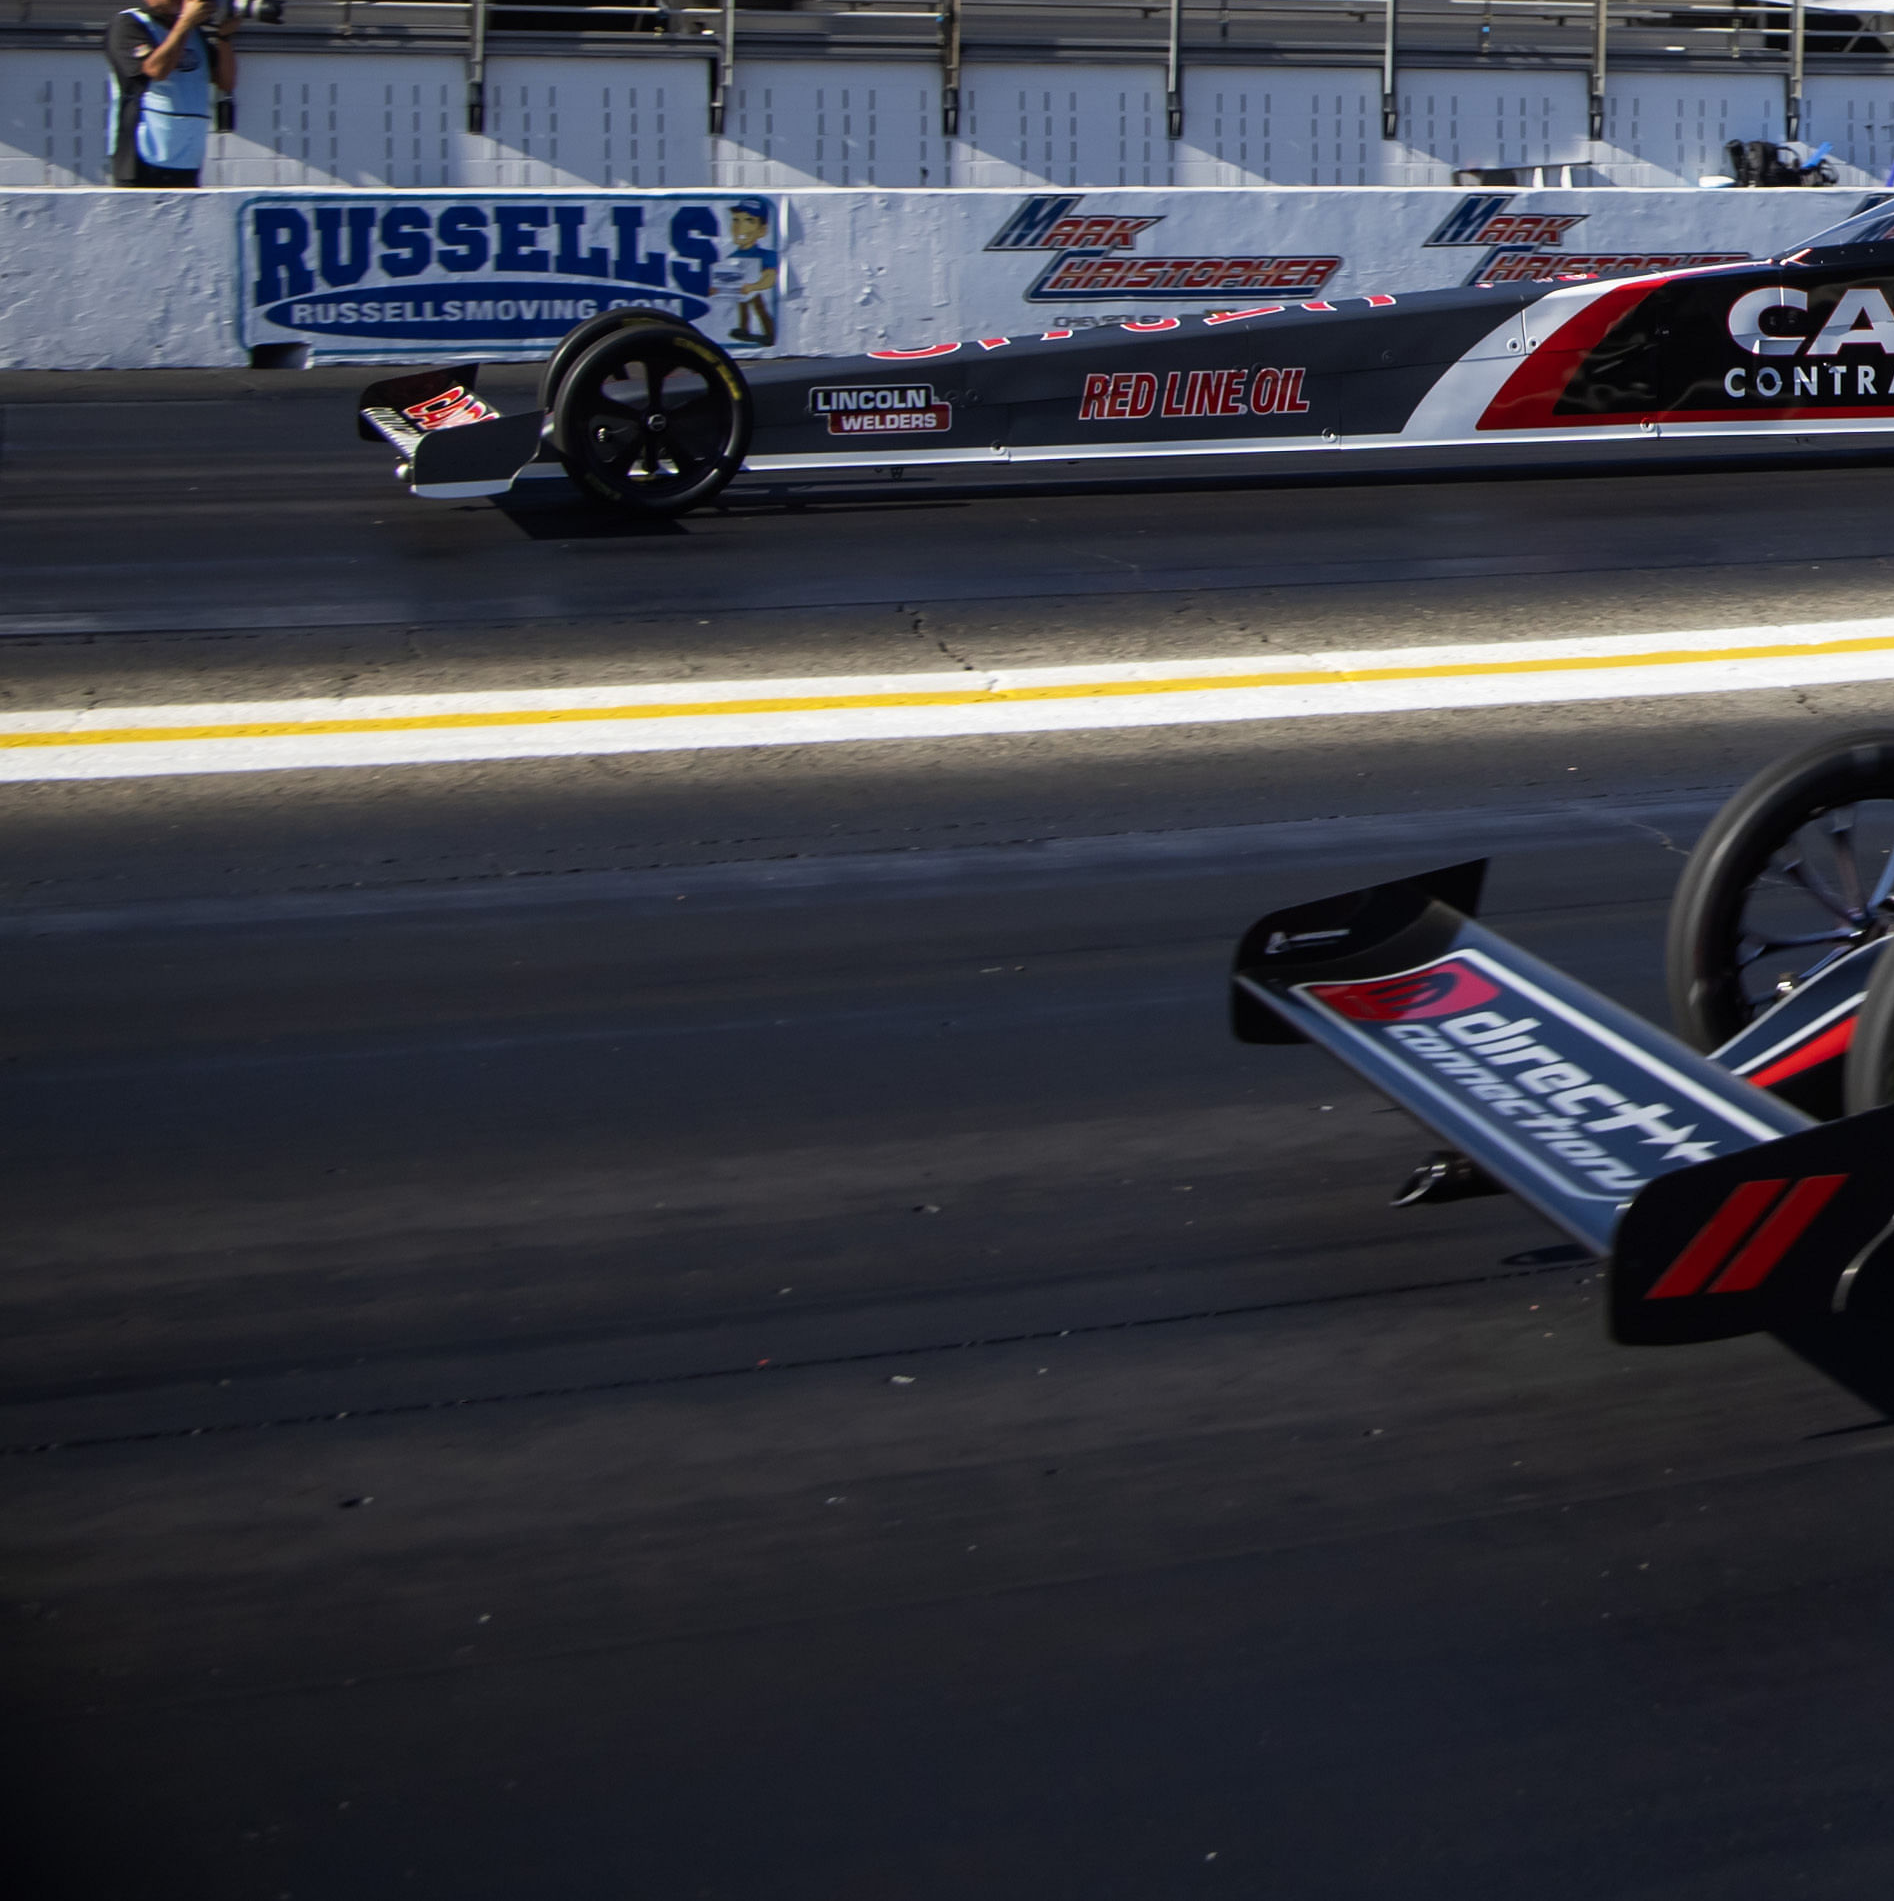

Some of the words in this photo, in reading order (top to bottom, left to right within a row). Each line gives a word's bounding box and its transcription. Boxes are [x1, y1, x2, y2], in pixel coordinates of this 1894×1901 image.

[983, 195, 1166, 251] MARK
[1424, 194, 1589, 248] MARK
[252, 205, 722, 299] RUSSELLS
[1024, 247, 1343, 303] CHRISTOPHER
[290, 298, 685, 327] RUSSELLSMOVINGCM
[813, 388, 928, 411] LINCOLN
[1078, 372, 1158, 420] RED
[1161, 369, 1248, 418] LINE
[1251, 367, 1310, 414] OIL
[841, 412, 940, 431] WELDERS
